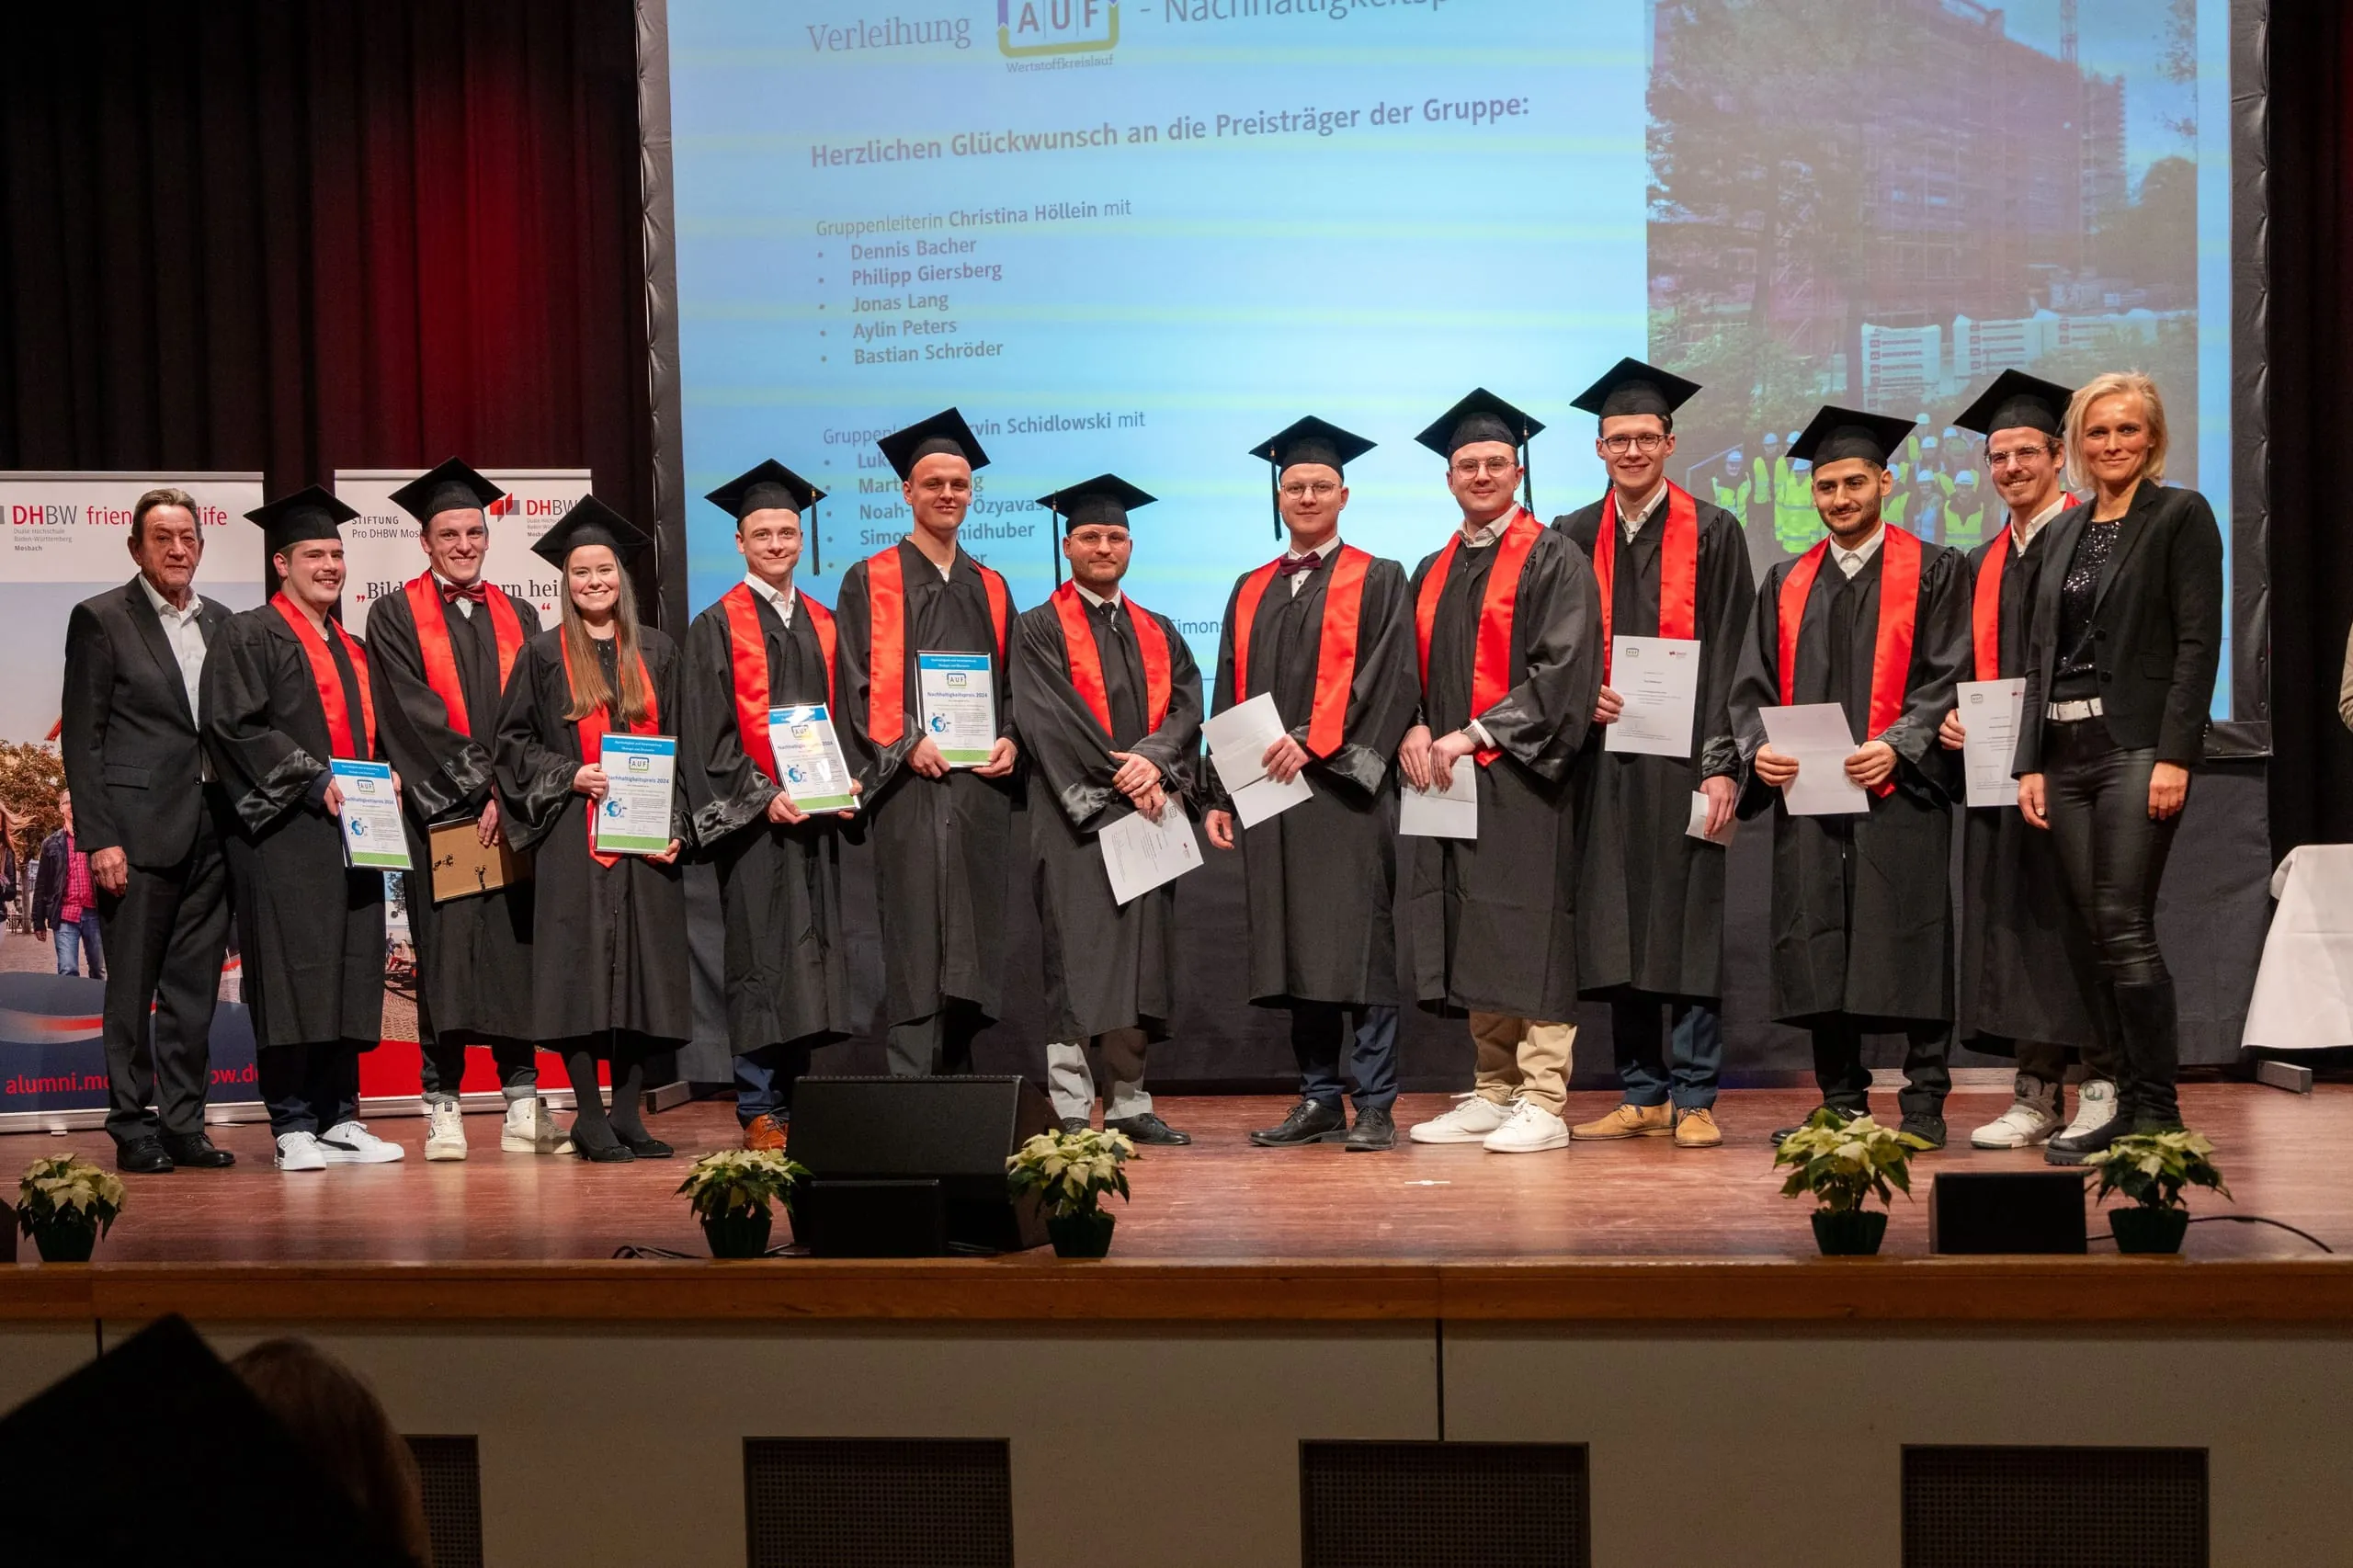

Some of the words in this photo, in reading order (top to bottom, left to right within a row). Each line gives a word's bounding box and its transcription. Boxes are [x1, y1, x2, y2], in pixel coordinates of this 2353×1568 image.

[807, 16, 972, 53] Verleihung
[1017, 0, 1099, 33] AUF
[1006, 53, 1114, 73] Wertstoffkreislauf
[810, 136, 942, 168] Herzlichen
[950, 121, 1119, 157] Glückwunsch
[1127, 123, 1158, 144] an
[1167, 116, 1207, 142] die
[1215, 106, 1360, 138] Preisträger
[1370, 100, 1415, 126] der
[1423, 95, 1529, 126] Gruppe:
[815, 210, 943, 238] Gruppenleiterin
[949, 205, 1028, 228] Christina
[1034, 199, 1097, 222] Höllein
[1104, 199, 1131, 217] mit
[851, 242, 910, 261] Dennis
[916, 236, 977, 257] Bacher
[851, 267, 912, 289] Philipp
[917, 261, 1003, 284] Giersberg
[852, 293, 902, 314] Jonas
[908, 291, 949, 312] Lang
[853, 320, 897, 342] Aylin
[903, 317, 957, 336] Peters
[854, 345, 918, 366] Bastian
[925, 339, 1005, 361] Schröder
[969, 419, 1001, 437] rvin
[1006, 412, 1111, 435] Schidlowski
[1118, 410, 1146, 428] mit
[858, 450, 888, 470] Luk
[858, 477, 902, 494] Mart
[12, 505, 77, 525] DHBW
[86, 506, 134, 525] frien
[199, 506, 228, 525] life
[351, 516, 400, 525] STIFTUNG
[859, 503, 912, 521] Noah-
[352, 528, 367, 539] Pro
[369, 528, 398, 539] DHBW
[958, 523, 1036, 540] midhuber
[14, 544, 43, 552] Mosbach
[529, 579, 560, 597] hei
[1171, 619, 1222, 635] imon
[608, 774, 656, 784] achhaltigkeitspreis
[345, 797, 384, 805] achhaltigkeitspreis
